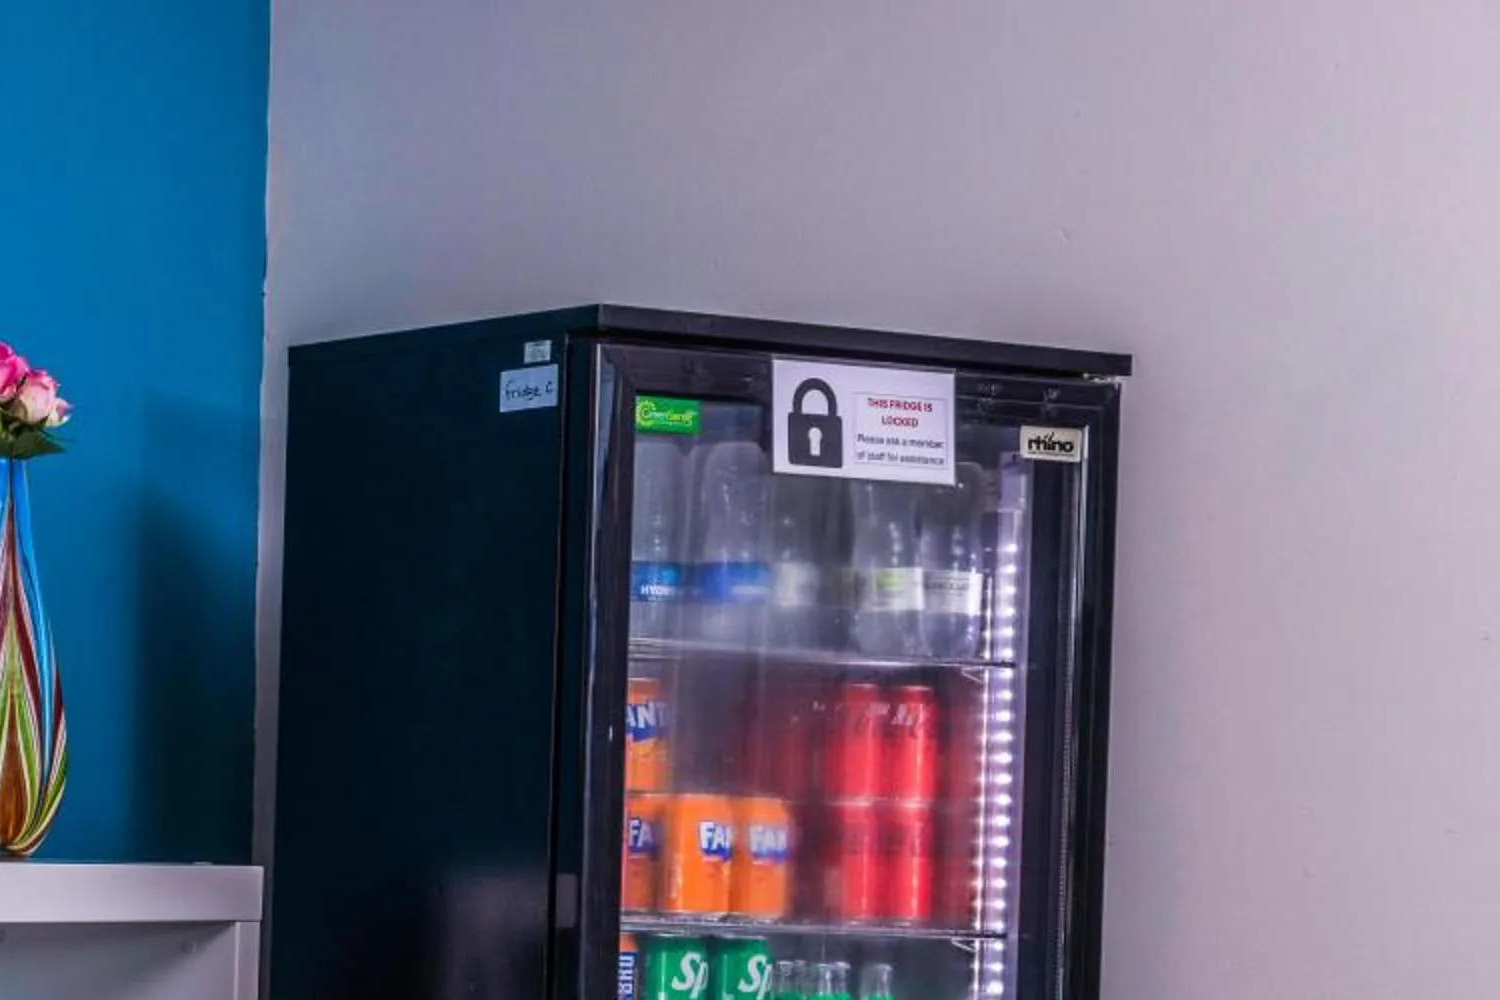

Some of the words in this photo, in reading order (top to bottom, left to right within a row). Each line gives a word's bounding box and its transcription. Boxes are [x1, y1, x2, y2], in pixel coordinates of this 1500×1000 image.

[867, 398, 888, 408] THIS
[889, 399, 922, 412] FRIDGE
[923, 402, 933, 412] IS
[881, 415, 919, 428] LOCKED
[1027, 432, 1074, 453] rhino
